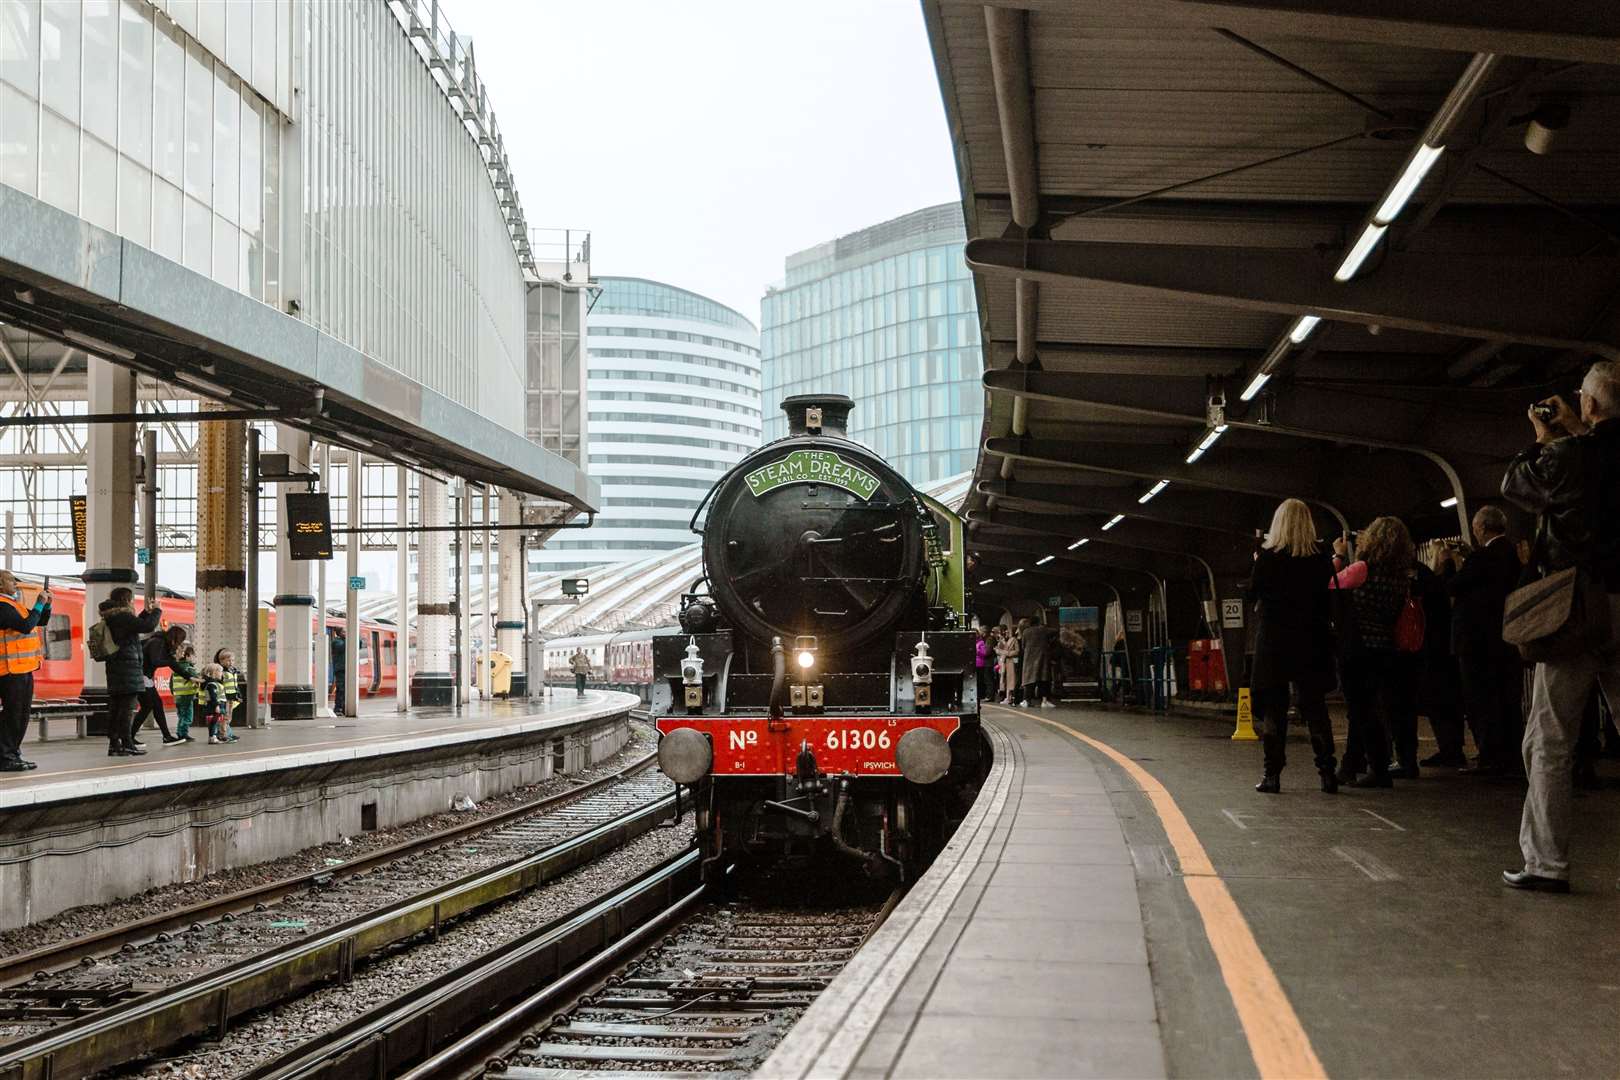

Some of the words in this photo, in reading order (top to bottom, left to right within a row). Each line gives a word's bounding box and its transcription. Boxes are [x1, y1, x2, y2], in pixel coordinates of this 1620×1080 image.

[804, 452, 824, 460] THE
[749, 461, 803, 488] STEAM
[810, 460, 875, 491] DREAMS
[777, 475, 795, 484] RAIL
[1225, 604, 1239, 615] 20
[826, 729, 891, 750] 61306
[863, 761, 896, 769] IPSWICH
